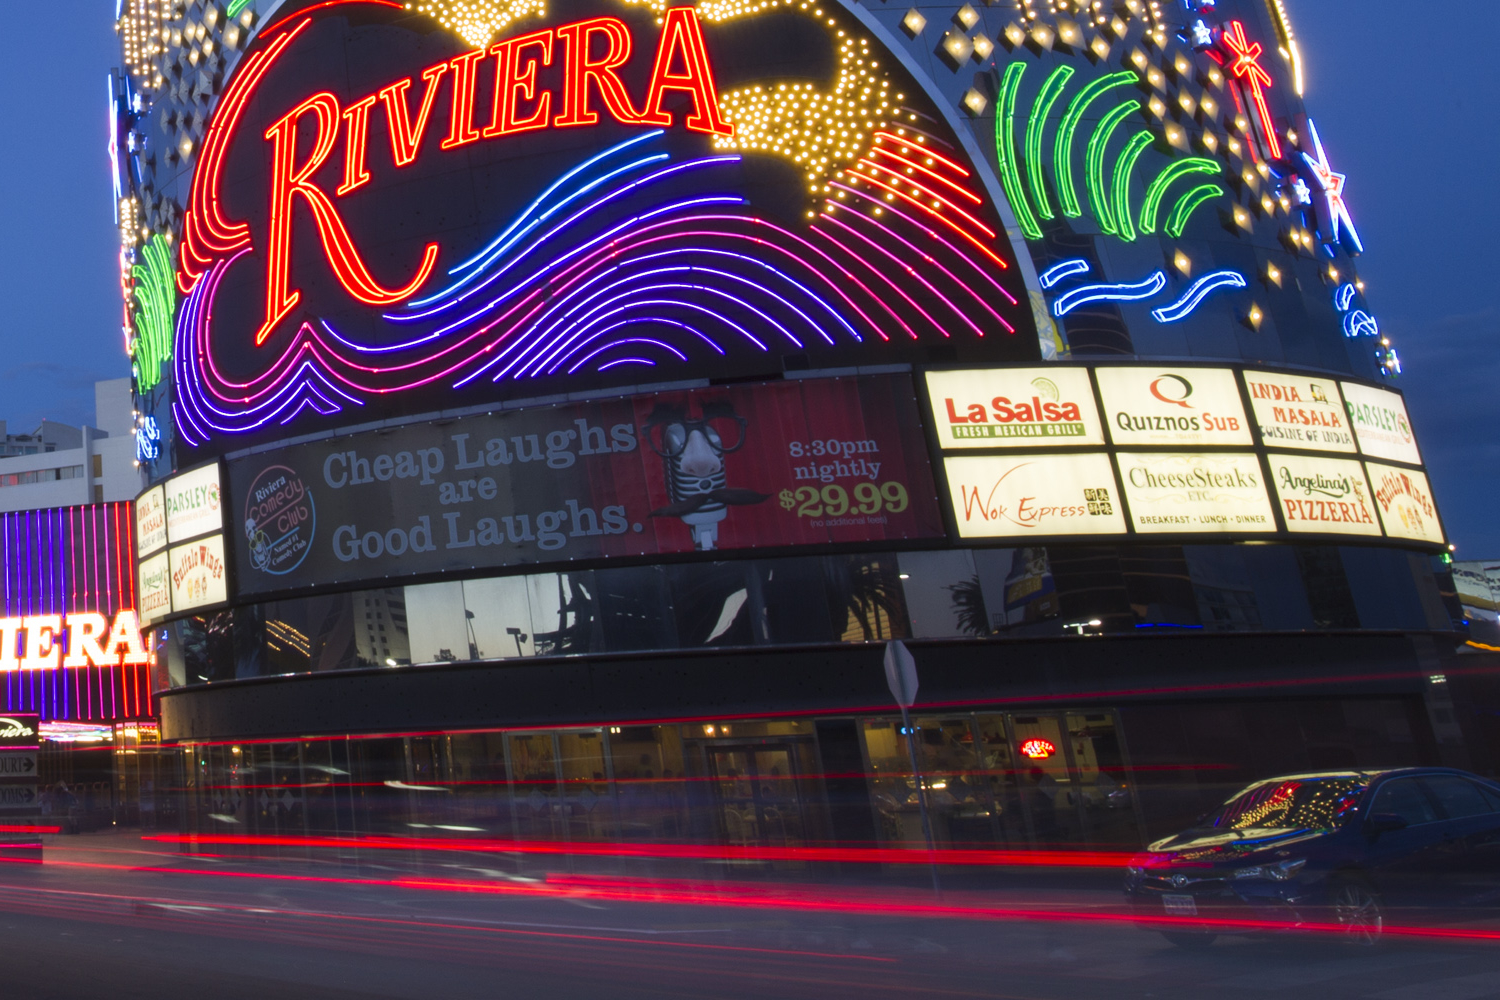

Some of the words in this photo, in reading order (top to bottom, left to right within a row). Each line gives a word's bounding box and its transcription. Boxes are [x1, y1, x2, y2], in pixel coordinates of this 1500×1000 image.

[255, 6, 736, 346] RIVIERA
[1249, 382, 1302, 403] INDIA
[945, 398, 989, 424] La
[991, 396, 1082, 423] Salsa
[1272, 406, 1342, 428] MASALA
[1345, 401, 1398, 433] PARSLEY
[956, 426, 989, 437] FRESH
[994, 425, 1043, 436] MEXICAN
[1047, 424, 1079, 435] GRILL
[1259, 425, 1304, 442] CUISINE
[1306, 430, 1319, 442] OF
[1321, 431, 1352, 445] INDIA
[323, 447, 444, 489] Cheap
[451, 418, 637, 469] Laughs
[789, 439, 880, 459] 8:30pm
[794, 459, 882, 483] nightly
[1129, 467, 1258, 488] CheeseSteaks
[1279, 466, 1350, 498] Angelina's
[167, 484, 208, 517] PARSLEY
[255, 476, 286, 503] Riviera
[439, 476, 497, 505] are
[778, 481, 909, 518] $29.99
[277, 506, 308, 533] Club
[1139, 516, 1190, 524] BREAKFAST
[1200, 516, 1228, 524] LUNCH
[1236, 515, 1267, 523] DINNER
[1284, 498, 1373, 524] PIZZERIA
[332, 515, 437, 562] Good
[442, 499, 643, 550] Laughs.
[272, 549, 293, 566] Comedy
[292, 540, 307, 553] Club
[273, 537, 294, 555] Named
